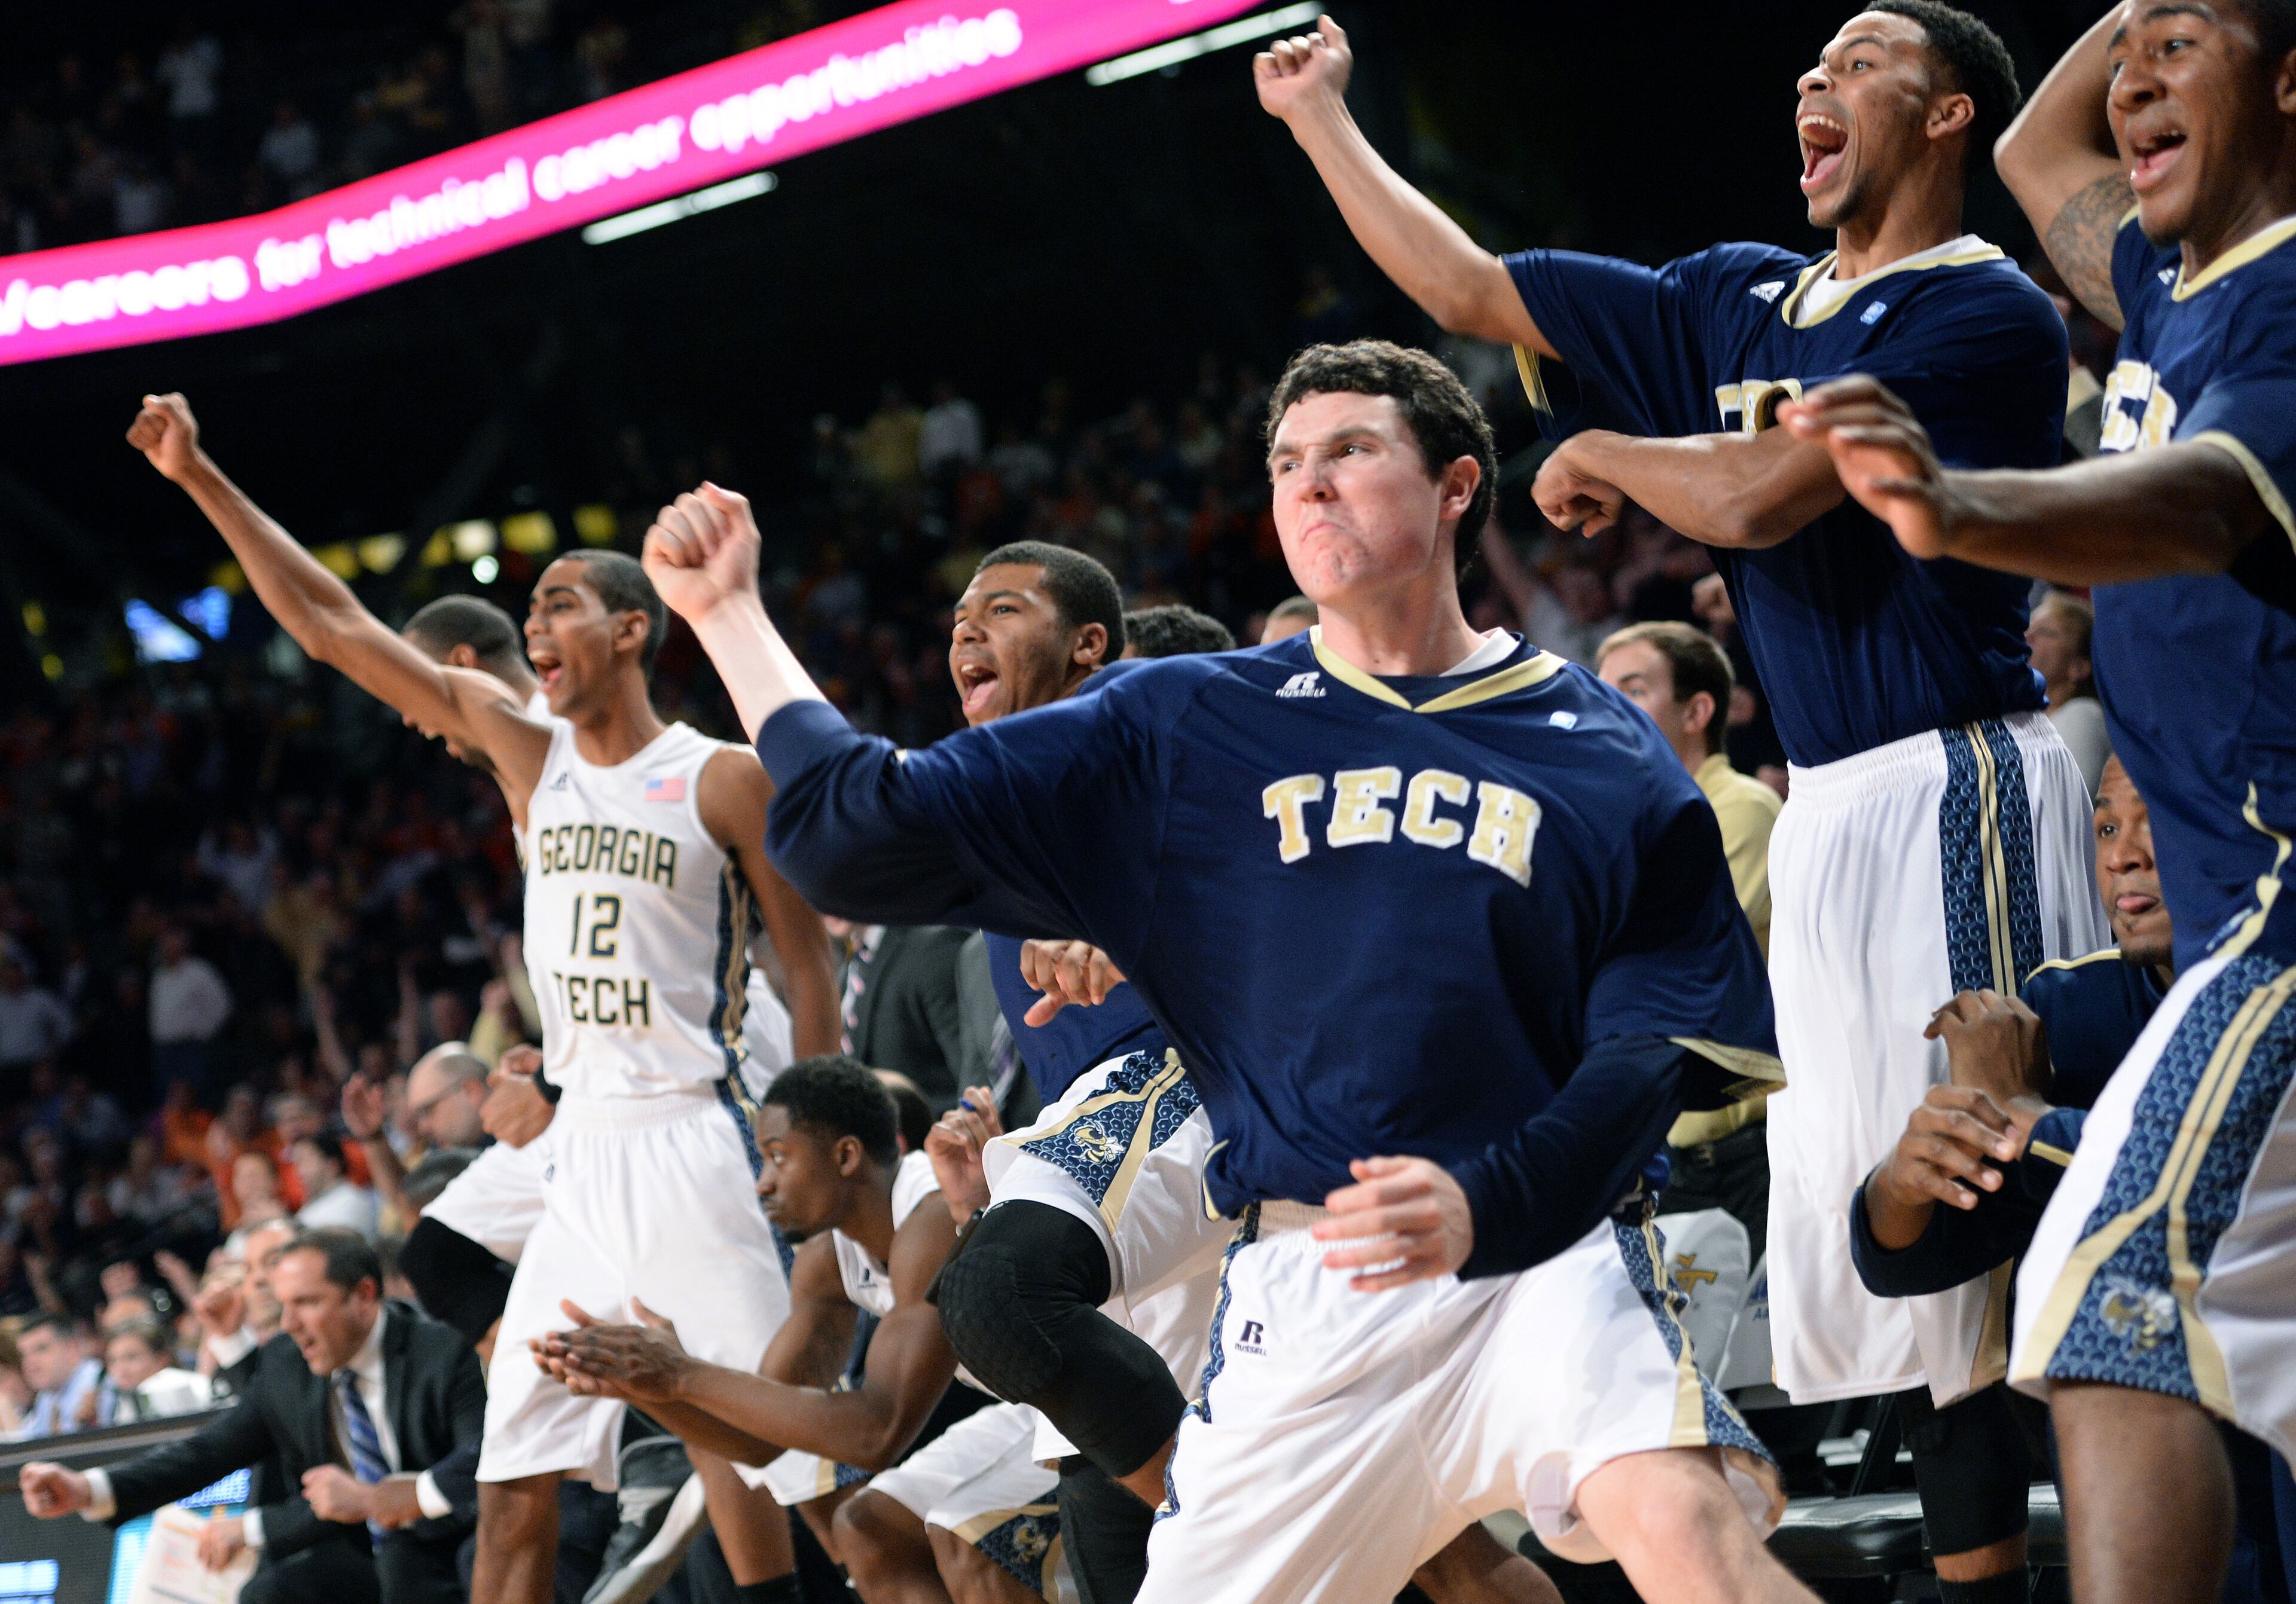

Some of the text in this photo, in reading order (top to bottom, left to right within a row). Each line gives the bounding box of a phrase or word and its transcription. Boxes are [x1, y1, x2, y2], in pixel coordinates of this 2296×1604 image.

[254, 233, 323, 292] for
[326, 156, 530, 268] technical
[533, 115, 686, 201] career
[689, 8, 1022, 154] opportunities
[1275, 687, 1327, 698] RUSSELL
[539, 822, 679, 890] GEORGIA
[1262, 766, 1542, 888] TECH
[570, 891, 622, 958] 12
[1235, 1343, 1267, 1356] RUSSELL
